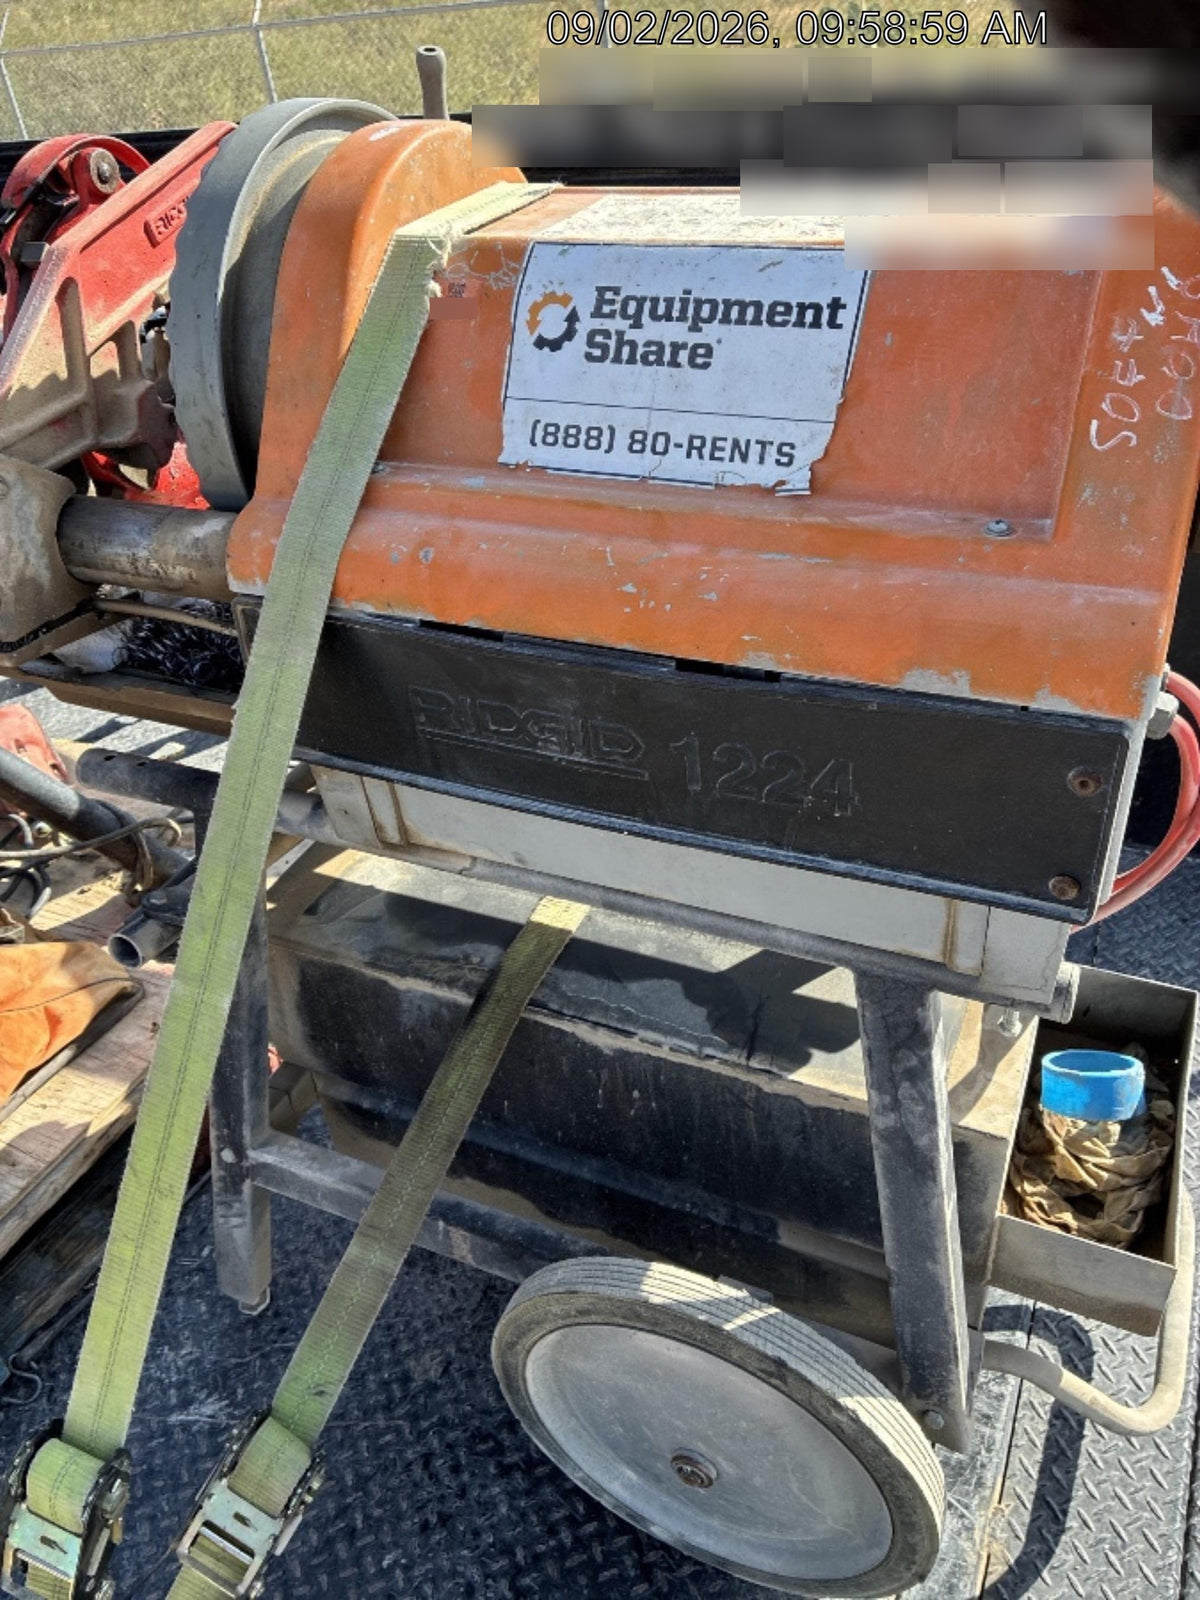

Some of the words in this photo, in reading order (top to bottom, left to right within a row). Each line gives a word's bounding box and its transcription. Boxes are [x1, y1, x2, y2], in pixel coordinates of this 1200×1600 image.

[590, 285, 847, 333] Equipment
[584, 328, 714, 370] Share
[529, 418, 616, 454] (888)
[627, 428, 796, 468] 80-RENTS
[408, 684, 647, 767] RIDGID
[670, 730, 859, 817] 1224
